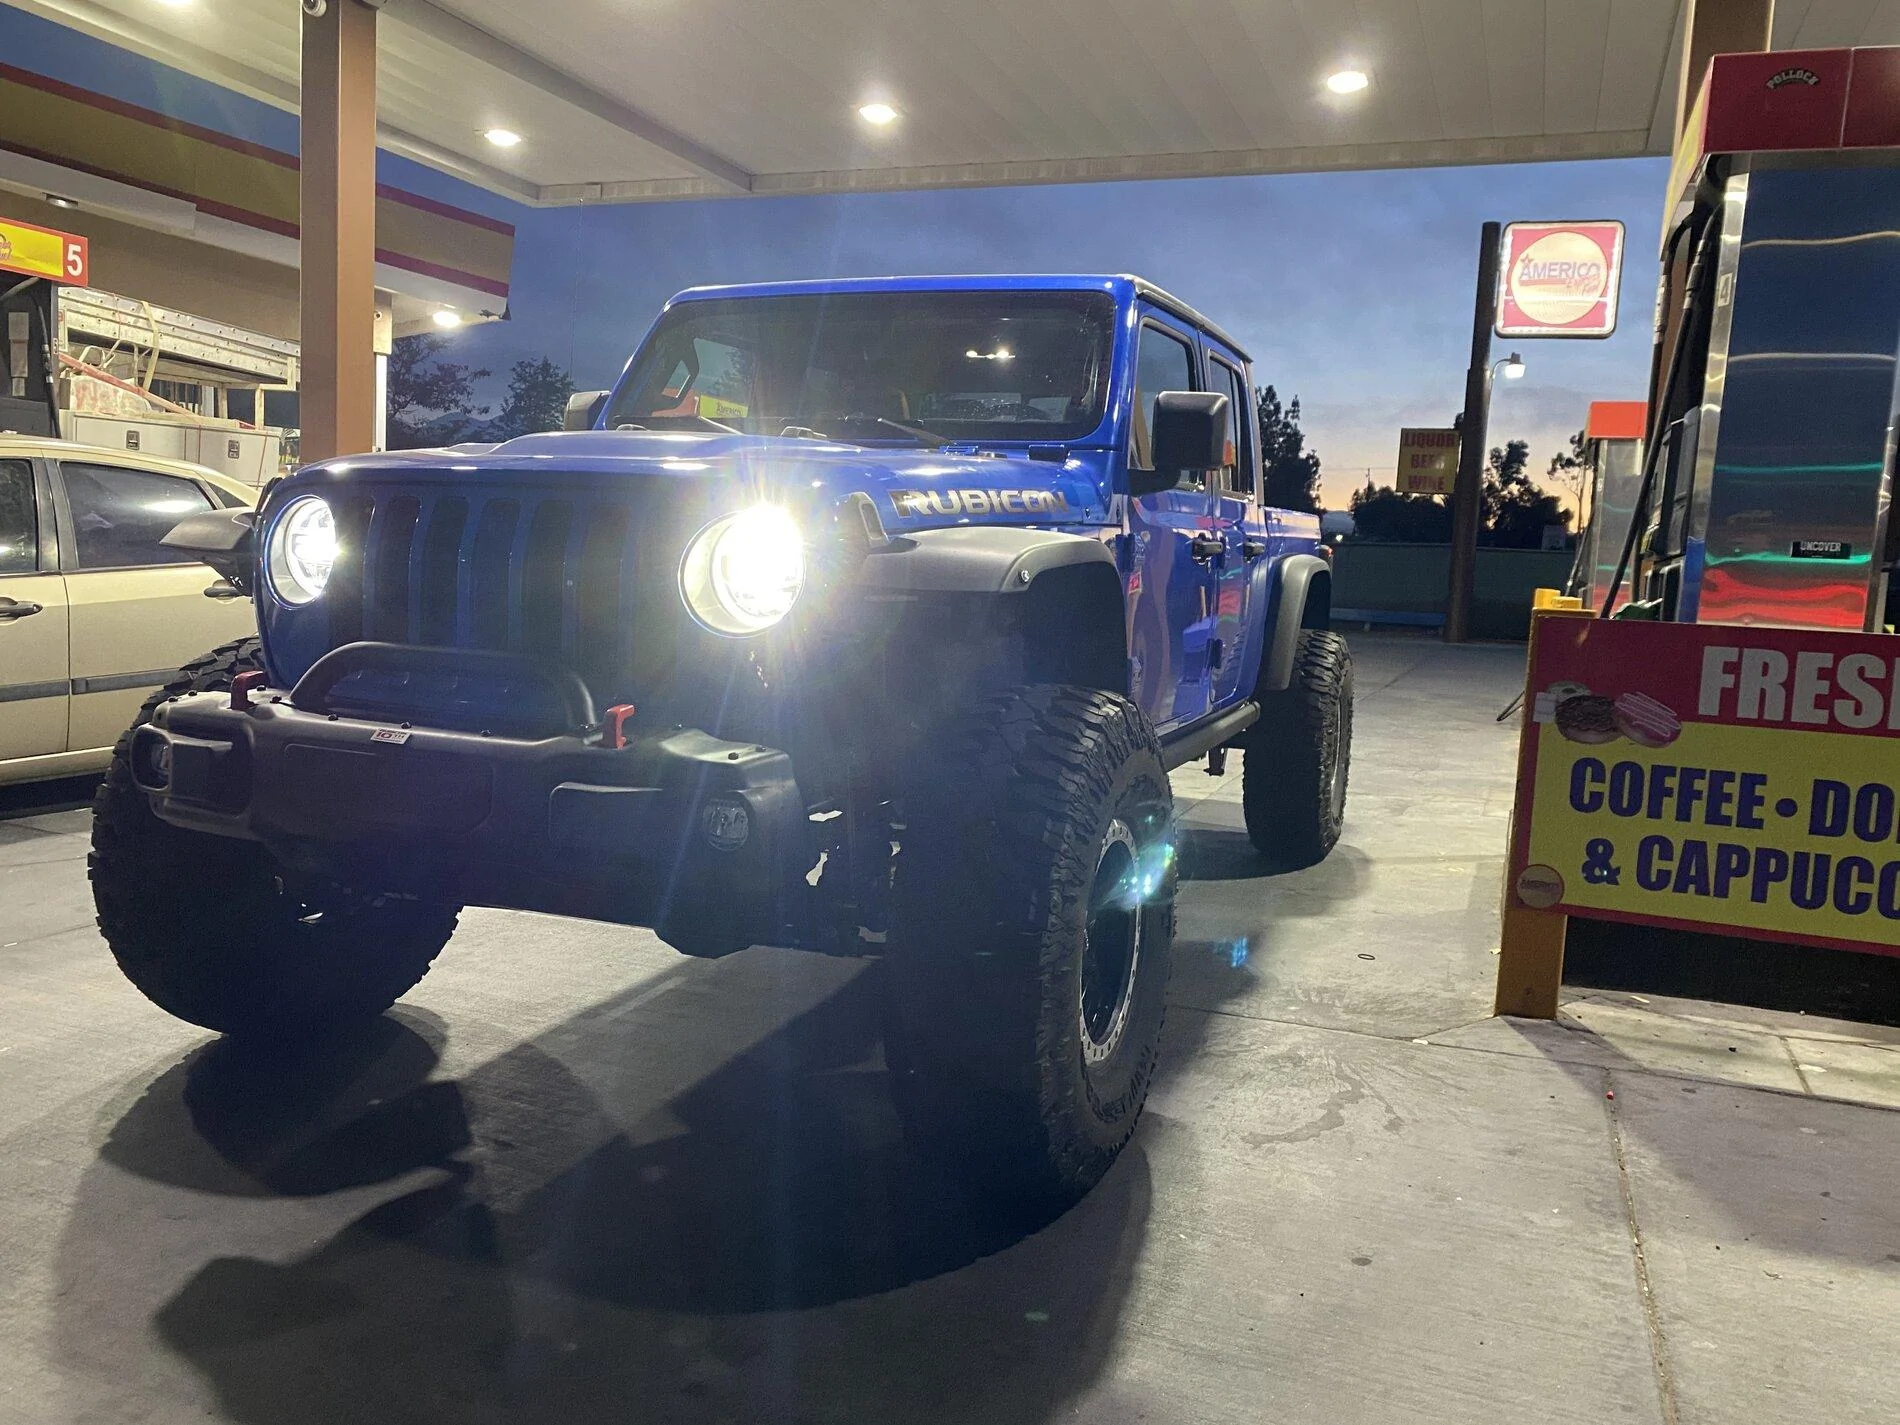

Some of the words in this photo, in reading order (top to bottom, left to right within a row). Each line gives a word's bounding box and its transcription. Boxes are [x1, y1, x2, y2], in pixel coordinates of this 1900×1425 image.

[1767, 69, 1819, 89] POLLOCK
[67, 243, 83, 277] 5
[1403, 432, 1456, 448] LIQUOR
[888, 489, 1069, 518] RUBICON
[1800, 541, 1841, 551] UNCOVER
[1698, 645, 1900, 730] FRES
[1569, 757, 1767, 830] COFFEE
[1808, 778, 1900, 844] DO
[1581, 837, 1621, 886] &
